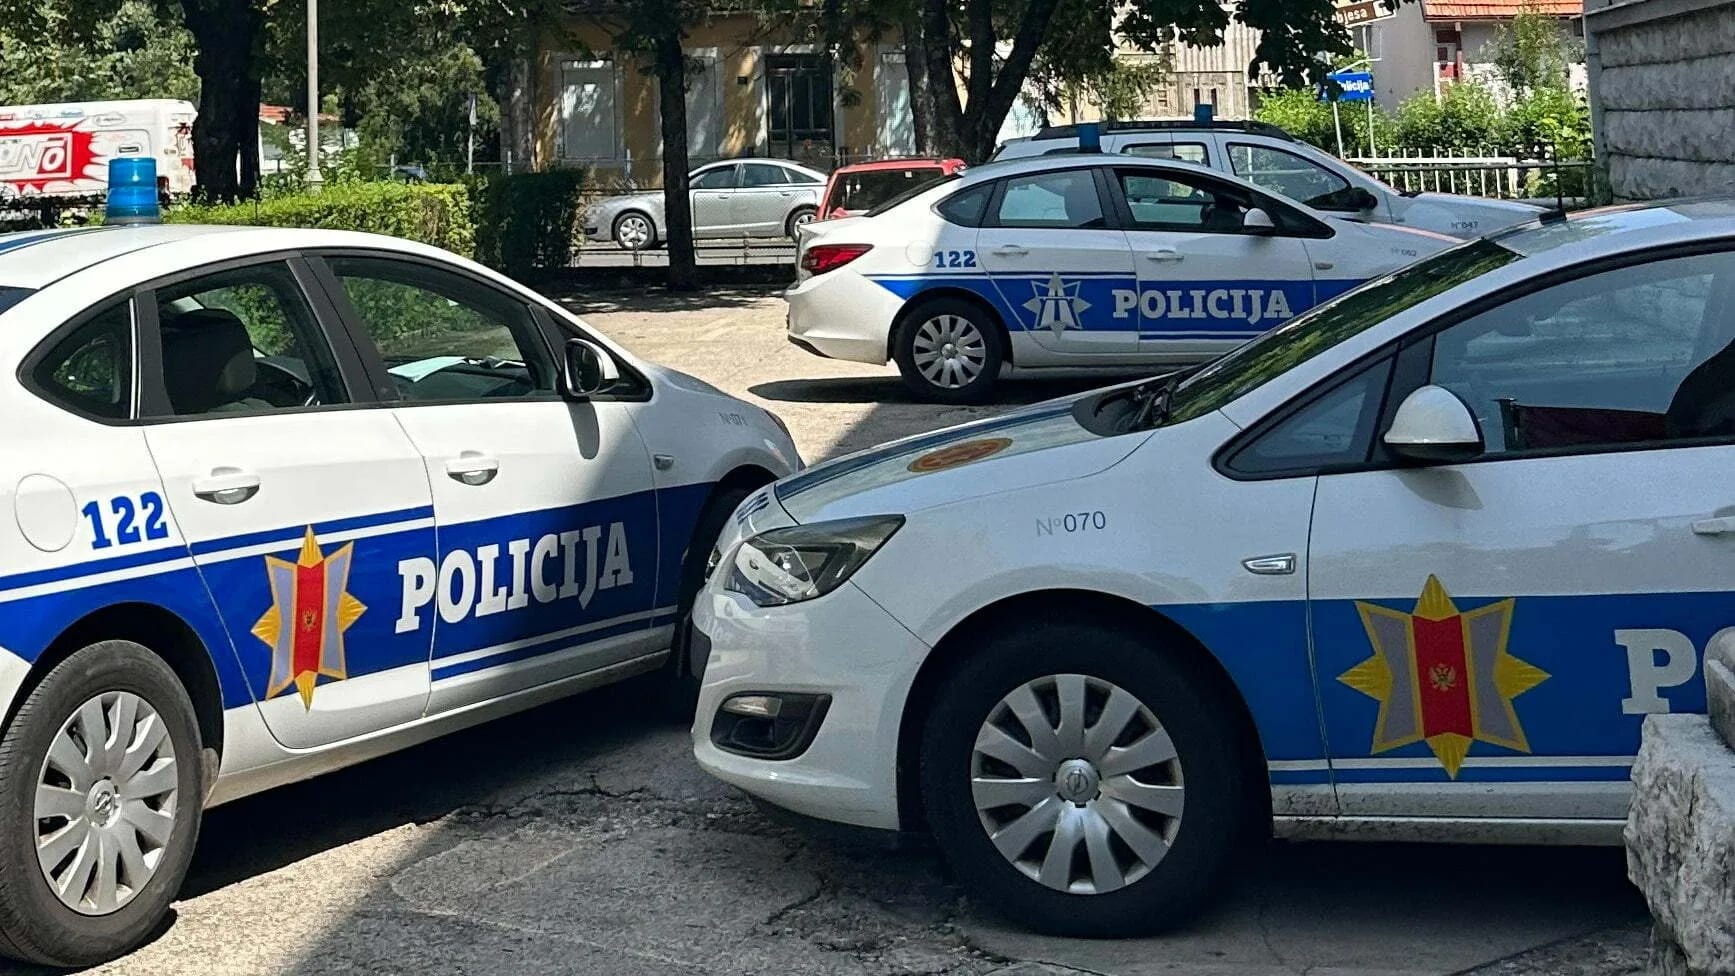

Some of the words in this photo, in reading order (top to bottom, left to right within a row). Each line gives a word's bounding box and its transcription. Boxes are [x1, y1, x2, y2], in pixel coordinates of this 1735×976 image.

[1338, 80, 1369, 93] licija
[934, 250, 977, 268] 122
[1112, 289, 1294, 325] POLICIJA
[81, 491, 169, 550] 122
[395, 521, 634, 634] POLICIJA
